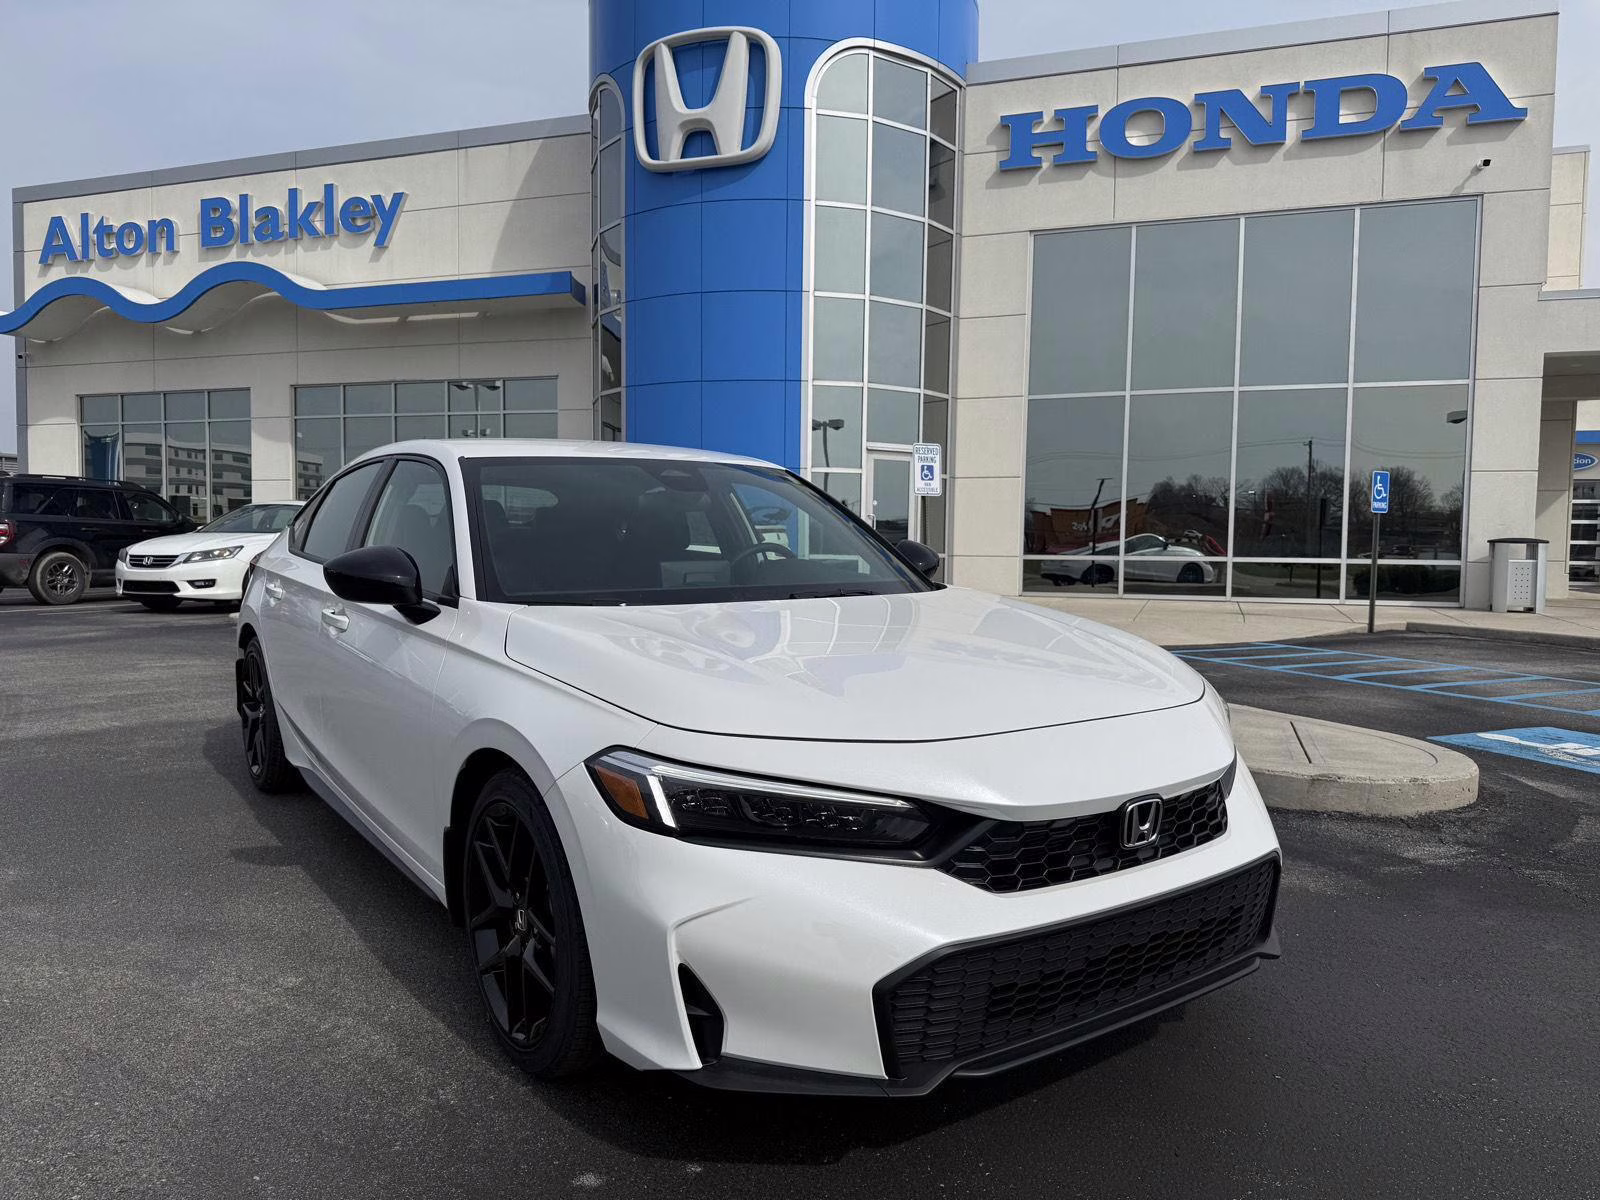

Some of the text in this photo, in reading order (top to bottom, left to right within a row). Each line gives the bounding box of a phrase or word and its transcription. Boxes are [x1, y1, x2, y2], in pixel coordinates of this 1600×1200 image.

[1000, 61, 1528, 171] HONDA
[38, 183, 407, 265] Alton Blakley
[915, 447, 938, 455] RESERVED
[1373, 501, 1387, 509] PARKING
